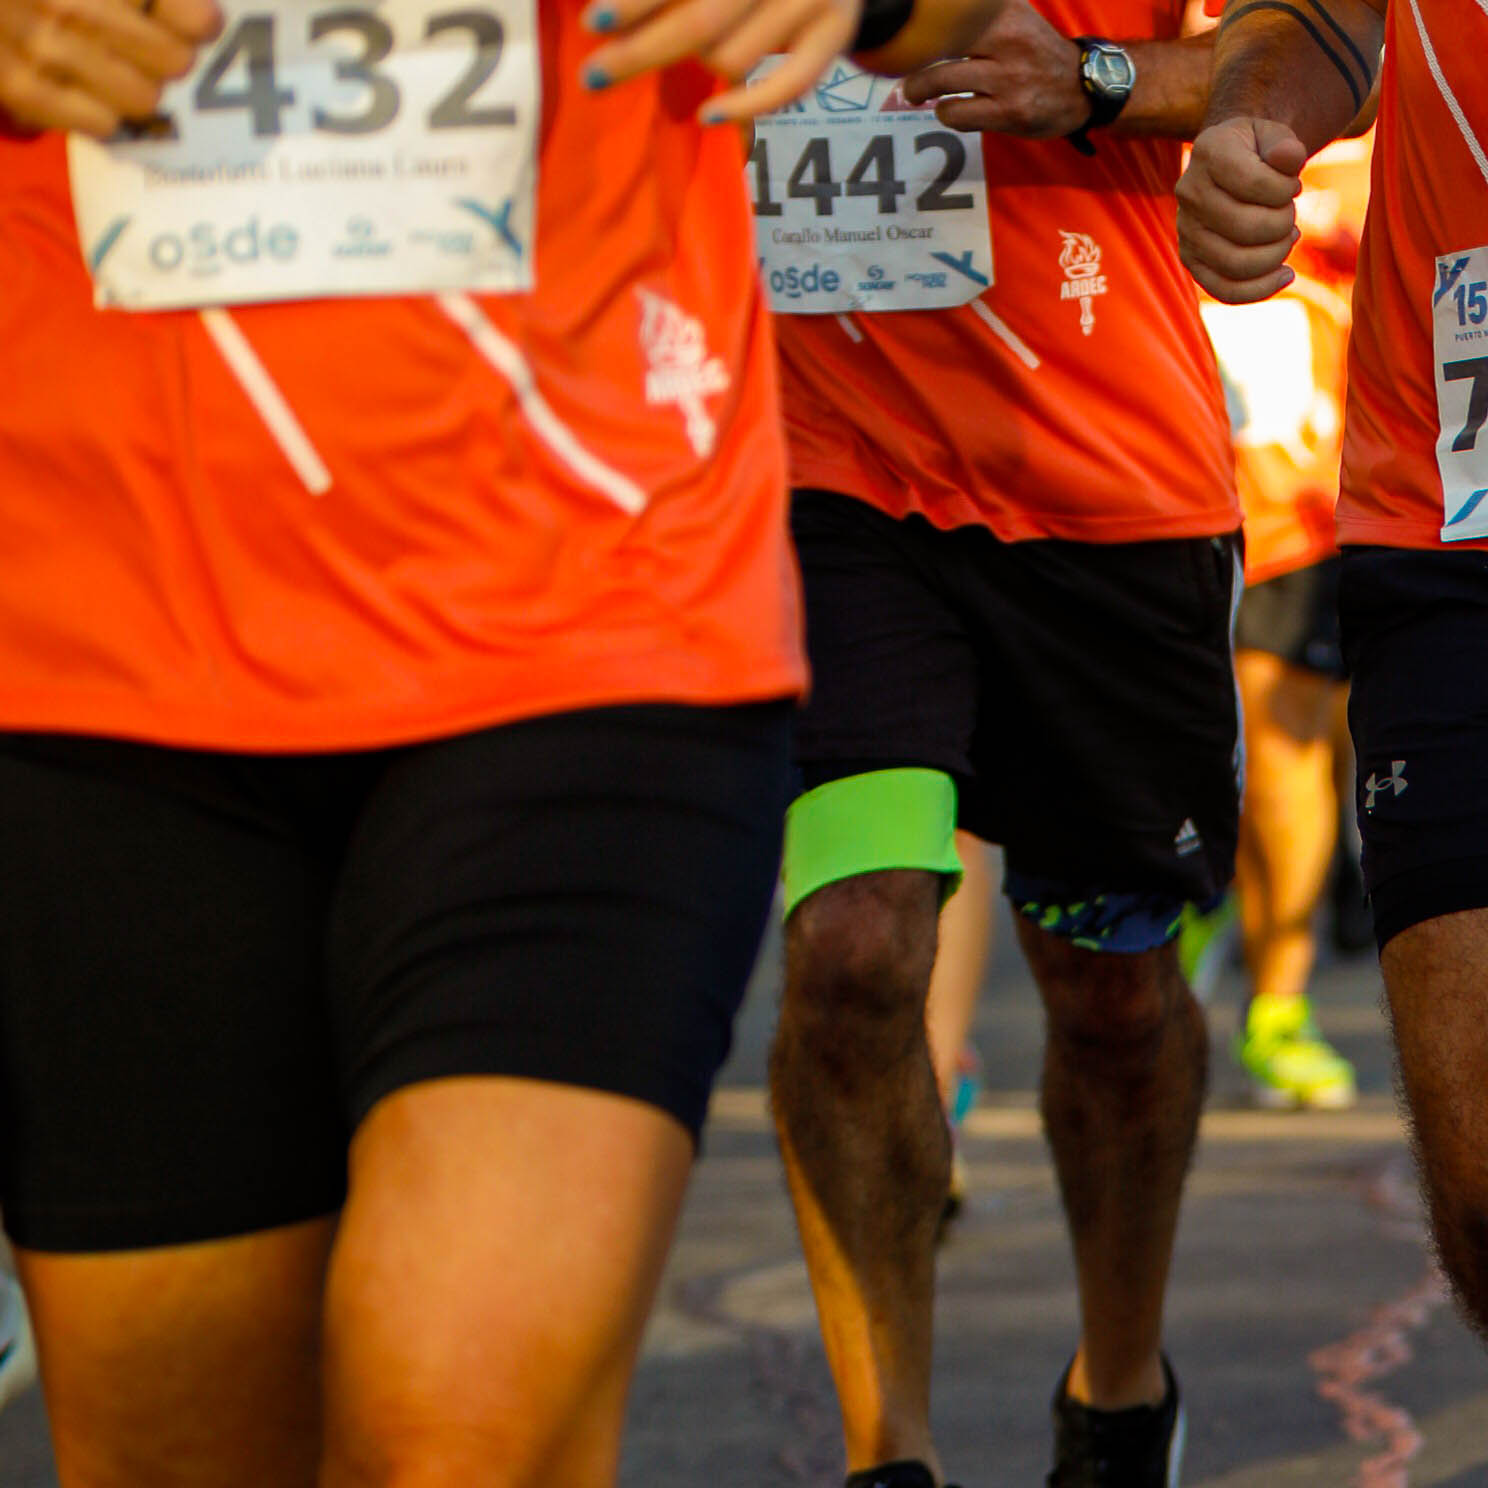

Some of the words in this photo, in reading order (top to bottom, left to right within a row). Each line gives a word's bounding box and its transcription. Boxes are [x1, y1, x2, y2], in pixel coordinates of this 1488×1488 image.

[103, 6, 518, 144] 432
[752, 130, 974, 216] 1442
[823, 226, 881, 242] Manuel
[886, 224, 934, 241] Oscar
[769, 264, 839, 297] osde
[1455, 329, 1482, 342] PUERTO
